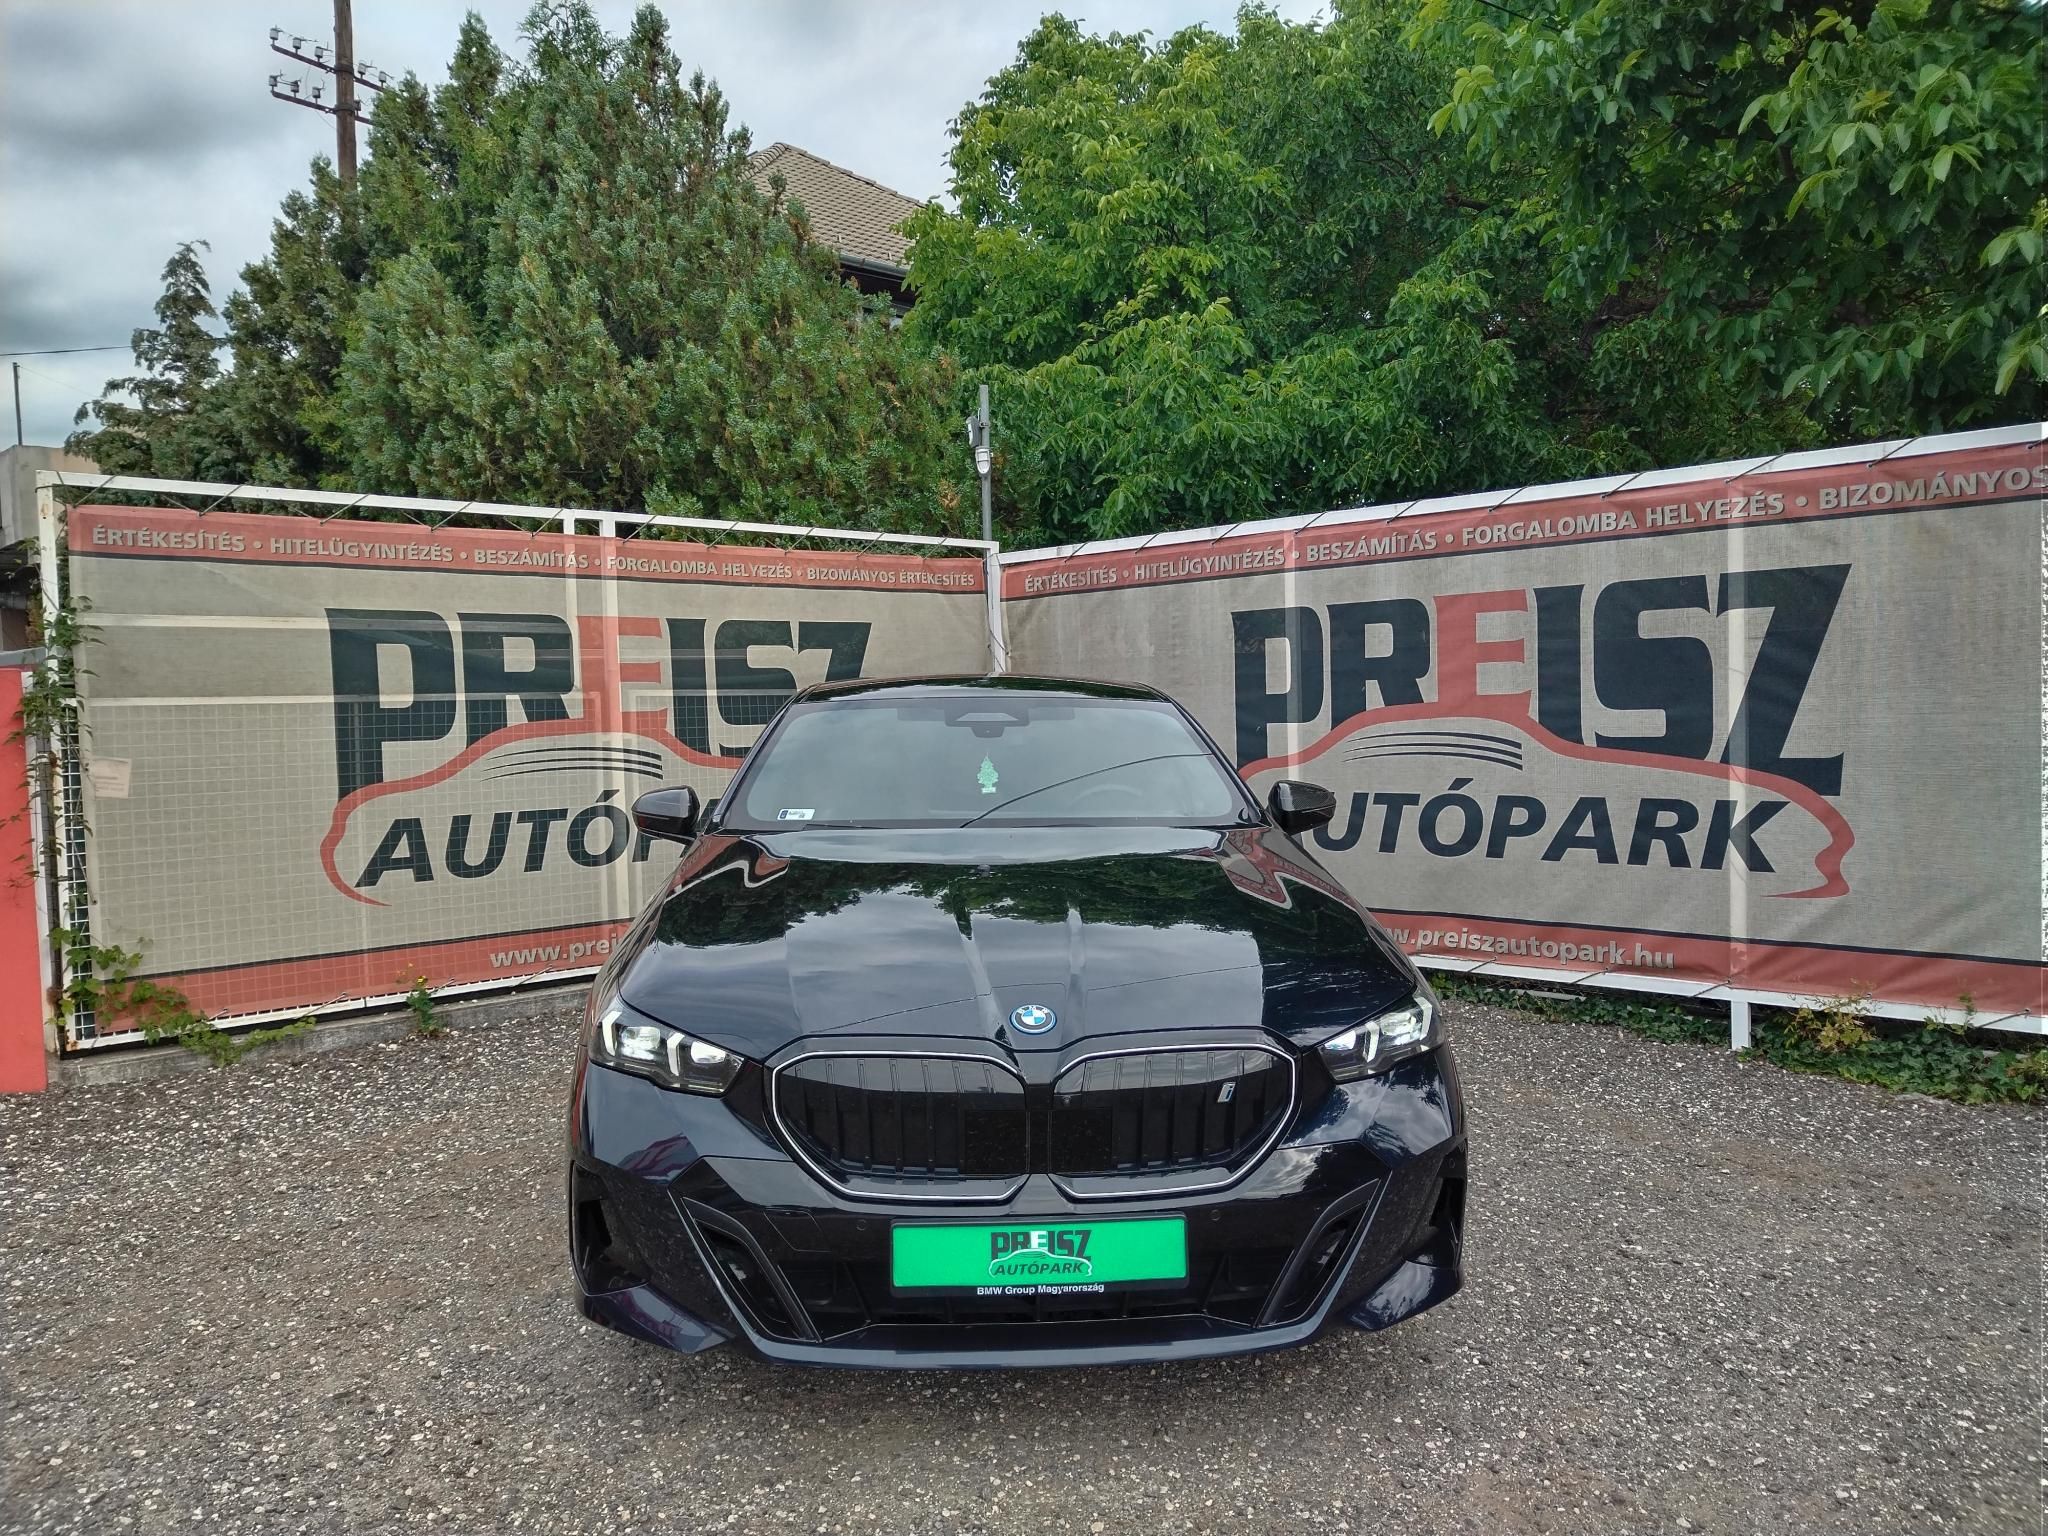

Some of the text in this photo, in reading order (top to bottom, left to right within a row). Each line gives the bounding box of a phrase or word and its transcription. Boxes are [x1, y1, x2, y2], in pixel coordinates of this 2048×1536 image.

[1025, 465, 2048, 592] ÉRTÉKESÍTÉS HITELÜGYINTÉZÉS BESZÁMÍTÁS FORGALOMBA HELYEZÉS BIZOMÁNYOS
[92, 524, 975, 587] ÉRTÉKESÍTÉS HITELÜGYINTÉZÉS BESZÁMÍTÁS FORGALOMBA HELYEZÉS BIZOMÁNYOS ÉRTÉKESÍTÉS
[1231, 563, 1853, 796] PREISZ
[1293, 778, 1792, 875] UTÓPARK
[489, 932, 622, 968] www.prei
[991, 1230, 1092, 1261] PREISZ
[994, 1261, 1084, 1276] AUTÓPARK
[977, 1283, 1105, 1295] BMW Group Magyarország
